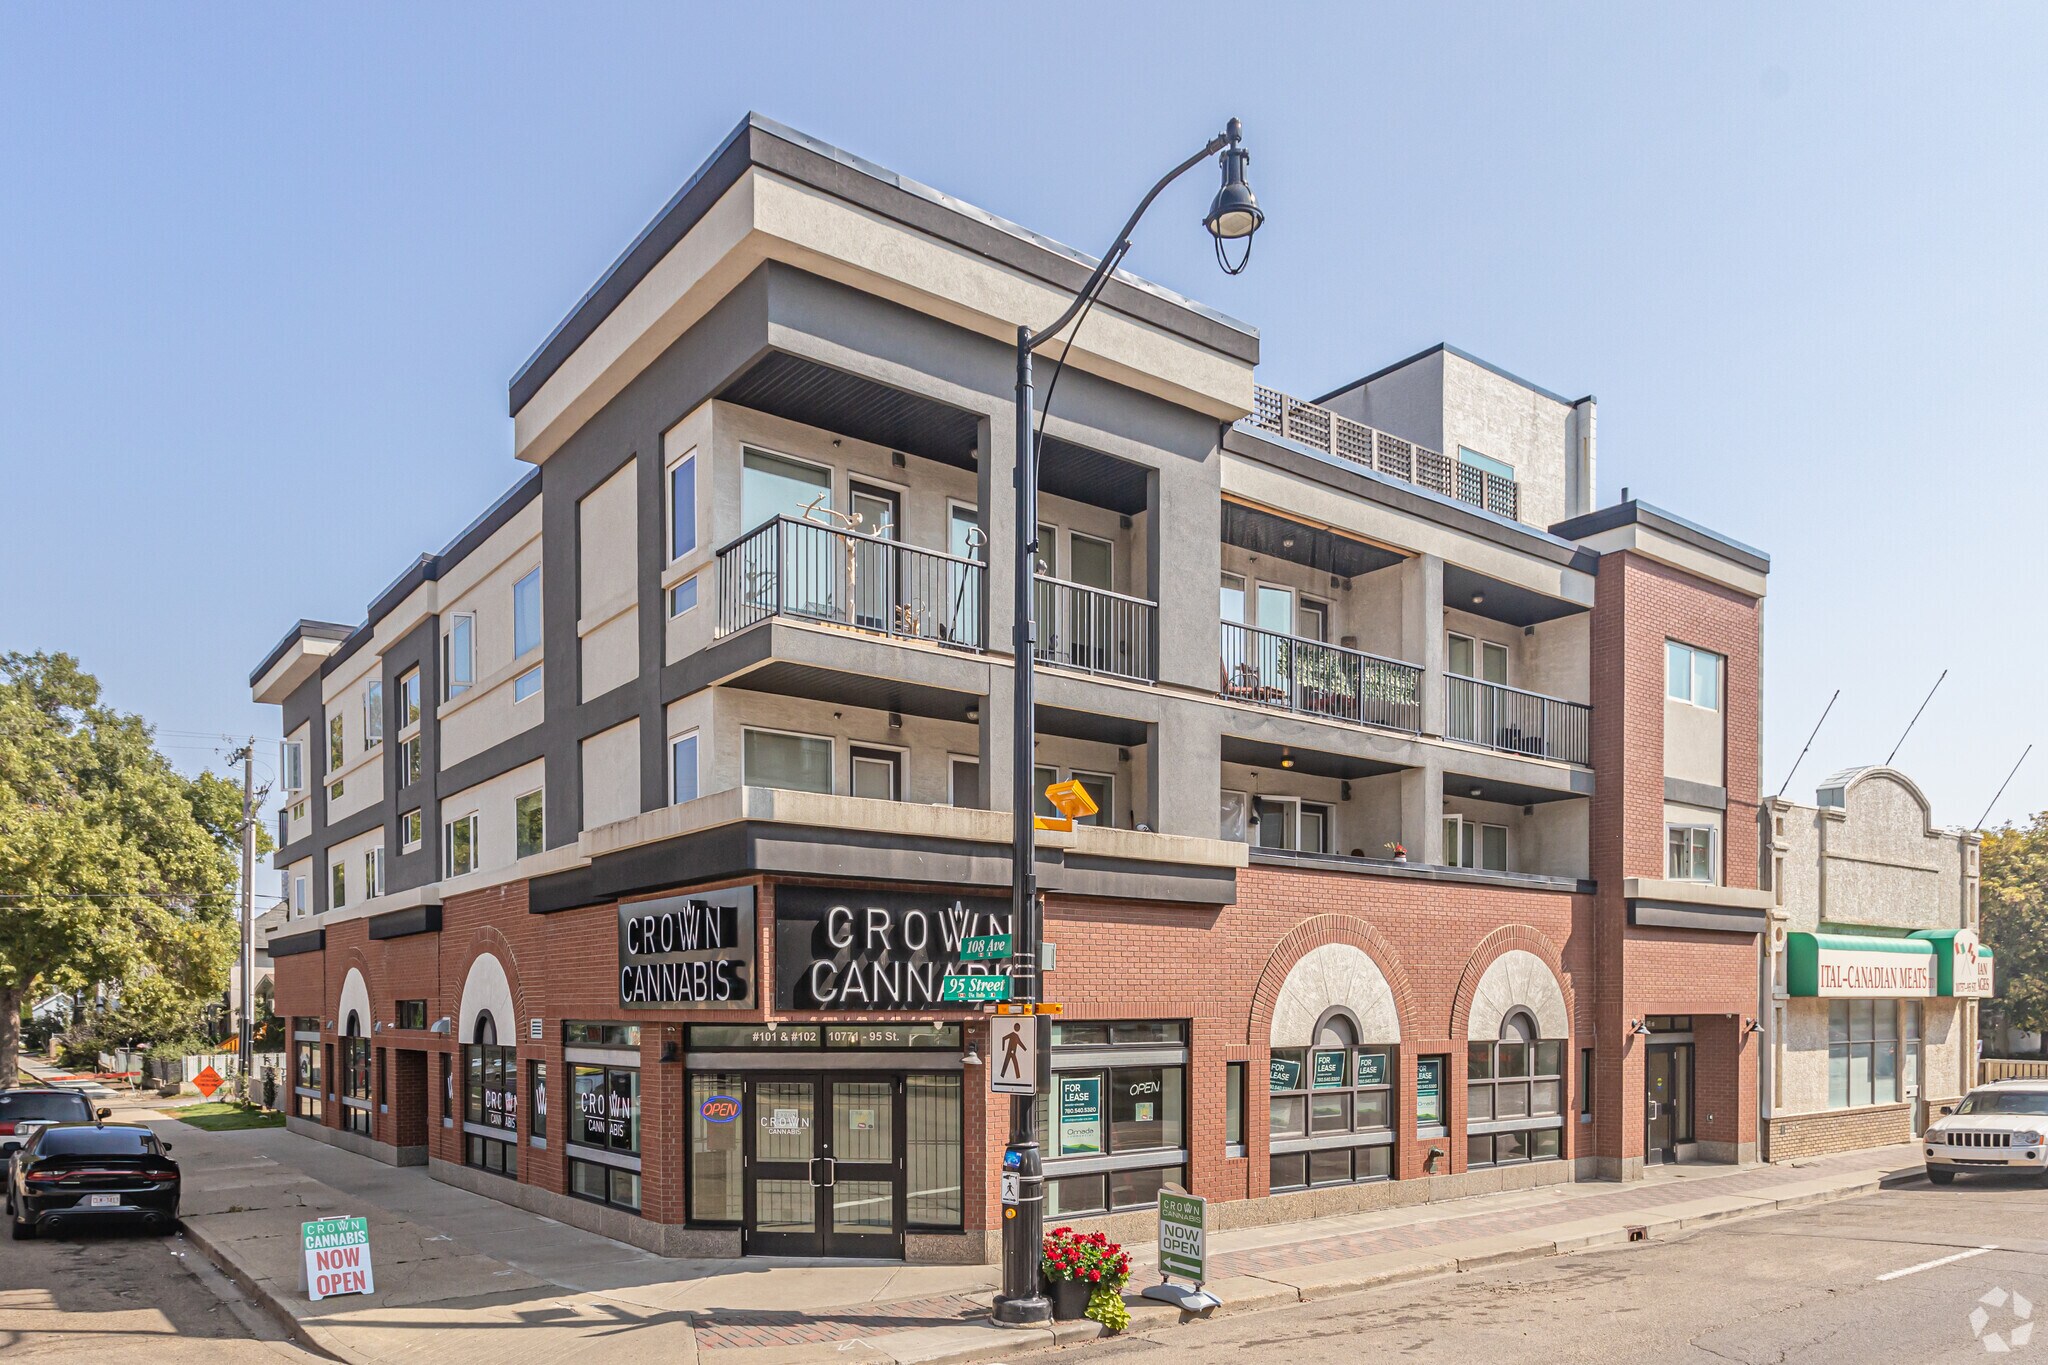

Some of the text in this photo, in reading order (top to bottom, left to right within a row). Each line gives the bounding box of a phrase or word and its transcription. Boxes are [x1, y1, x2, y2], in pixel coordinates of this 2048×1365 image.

[627, 899, 721, 955] CROWN
[828, 900, 1013, 952] CROWN
[966, 938, 1006, 954] 108 Ave
[621, 959, 730, 1002] CANNABIS
[1820, 964, 1897, 989] ITAL-CANADIAN
[1899, 967, 1927, 989] MEATS
[948, 977, 1006, 994] 95 Street
[752, 1032, 777, 1041] #101
[780, 1032, 789, 1041] &
[791, 1032, 817, 1041] #102
[828, 1032, 859, 1041] 10771
[869, 1032, 882, 1041] 95
[885, 1032, 900, 1041] St.
[1271, 1063, 1285, 1072] FOR
[1318, 1056, 1331, 1064] FOR
[1360, 1059, 1373, 1067] FOR
[1317, 1064, 1337, 1072] LEASE
[1359, 1066, 1378, 1075] LEASE
[1270, 1071, 1290, 1081] LEASE
[1064, 1083, 1081, 1093] FOR
[1129, 1081, 1161, 1096] OPEN
[581, 1090, 630, 1119] CROWN
[1064, 1092, 1090, 1102] LEASE
[702, 1102, 738, 1117] OPEN
[588, 1119, 624, 1137] CANNABIS
[760, 1116, 810, 1127] CROWN
[1163, 1199, 1200, 1216] CROWN
[1162, 1209, 1202, 1224] CANNABIS
[307, 1220, 360, 1235] CROWN
[1164, 1223, 1199, 1242] NOW
[305, 1230, 367, 1249] CANNABIS
[1163, 1237, 1200, 1257] OPEN
[316, 1247, 360, 1271] NOW
[316, 1270, 367, 1296] OPEN
